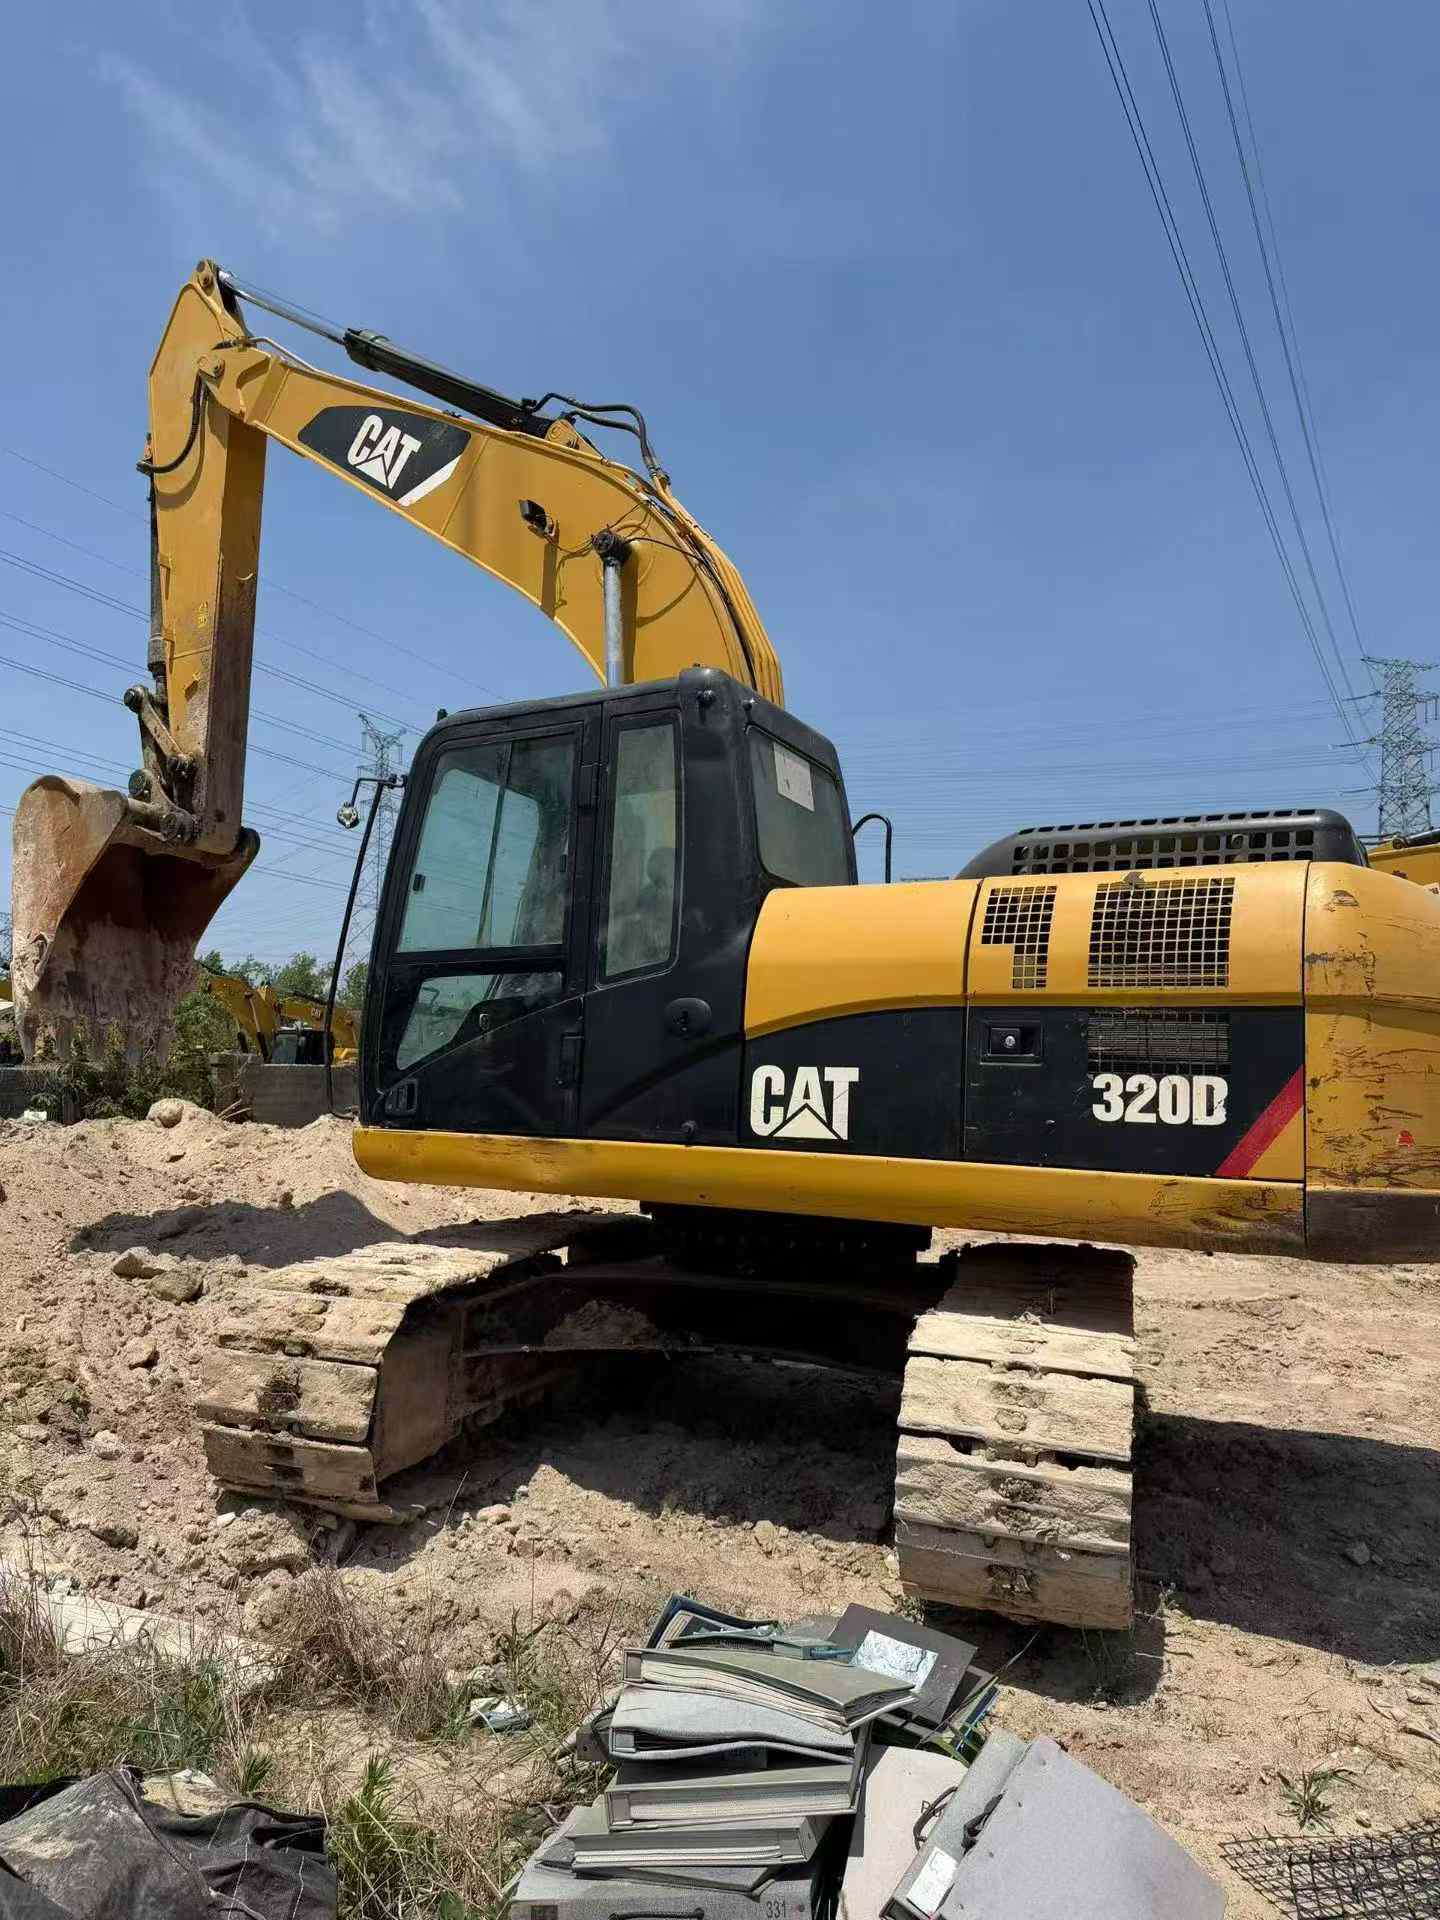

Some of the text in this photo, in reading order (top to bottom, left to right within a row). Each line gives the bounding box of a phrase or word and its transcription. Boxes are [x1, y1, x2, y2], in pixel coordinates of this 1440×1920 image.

[347, 414, 422, 489] CAT
[750, 1064, 860, 1141] CAT
[1092, 1073, 1229, 1126] 320D
[766, 1900, 786, 1918] 331
